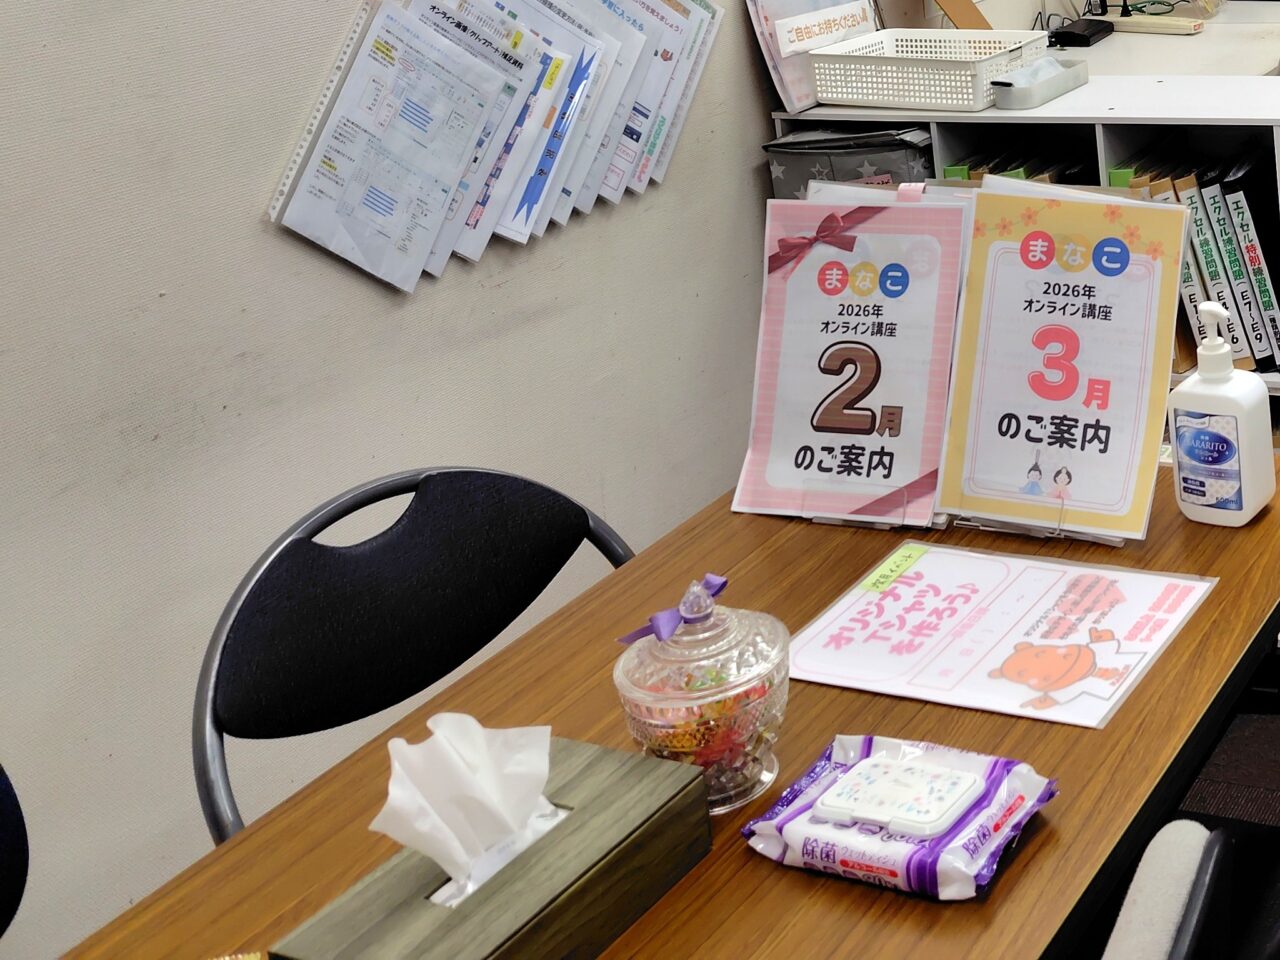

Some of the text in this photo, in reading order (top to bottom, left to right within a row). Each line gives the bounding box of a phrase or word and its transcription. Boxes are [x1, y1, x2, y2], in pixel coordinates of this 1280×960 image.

[786, 11, 864, 44] ご自由にお持ちください
[1025, 237, 1125, 271] まなこ
[823, 266, 905, 294] まなこ
[1042, 282, 1097, 300] 2026年
[838, 302, 884, 320] 2026年
[1023, 297, 1113, 321] オンライン講座
[820, 319, 898, 339] オンライン講座
[1027, 323, 1111, 411] 3月
[810, 339, 905, 438] 2月
[997, 411, 1112, 456] のご案内
[793, 443, 896, 480] のご案内
[822, 570, 925, 651] オリジナル
[862, 583, 942, 645] Tシャツ
[801, 836, 838, 865] 除菌
[961, 823, 993, 860] 除菌
